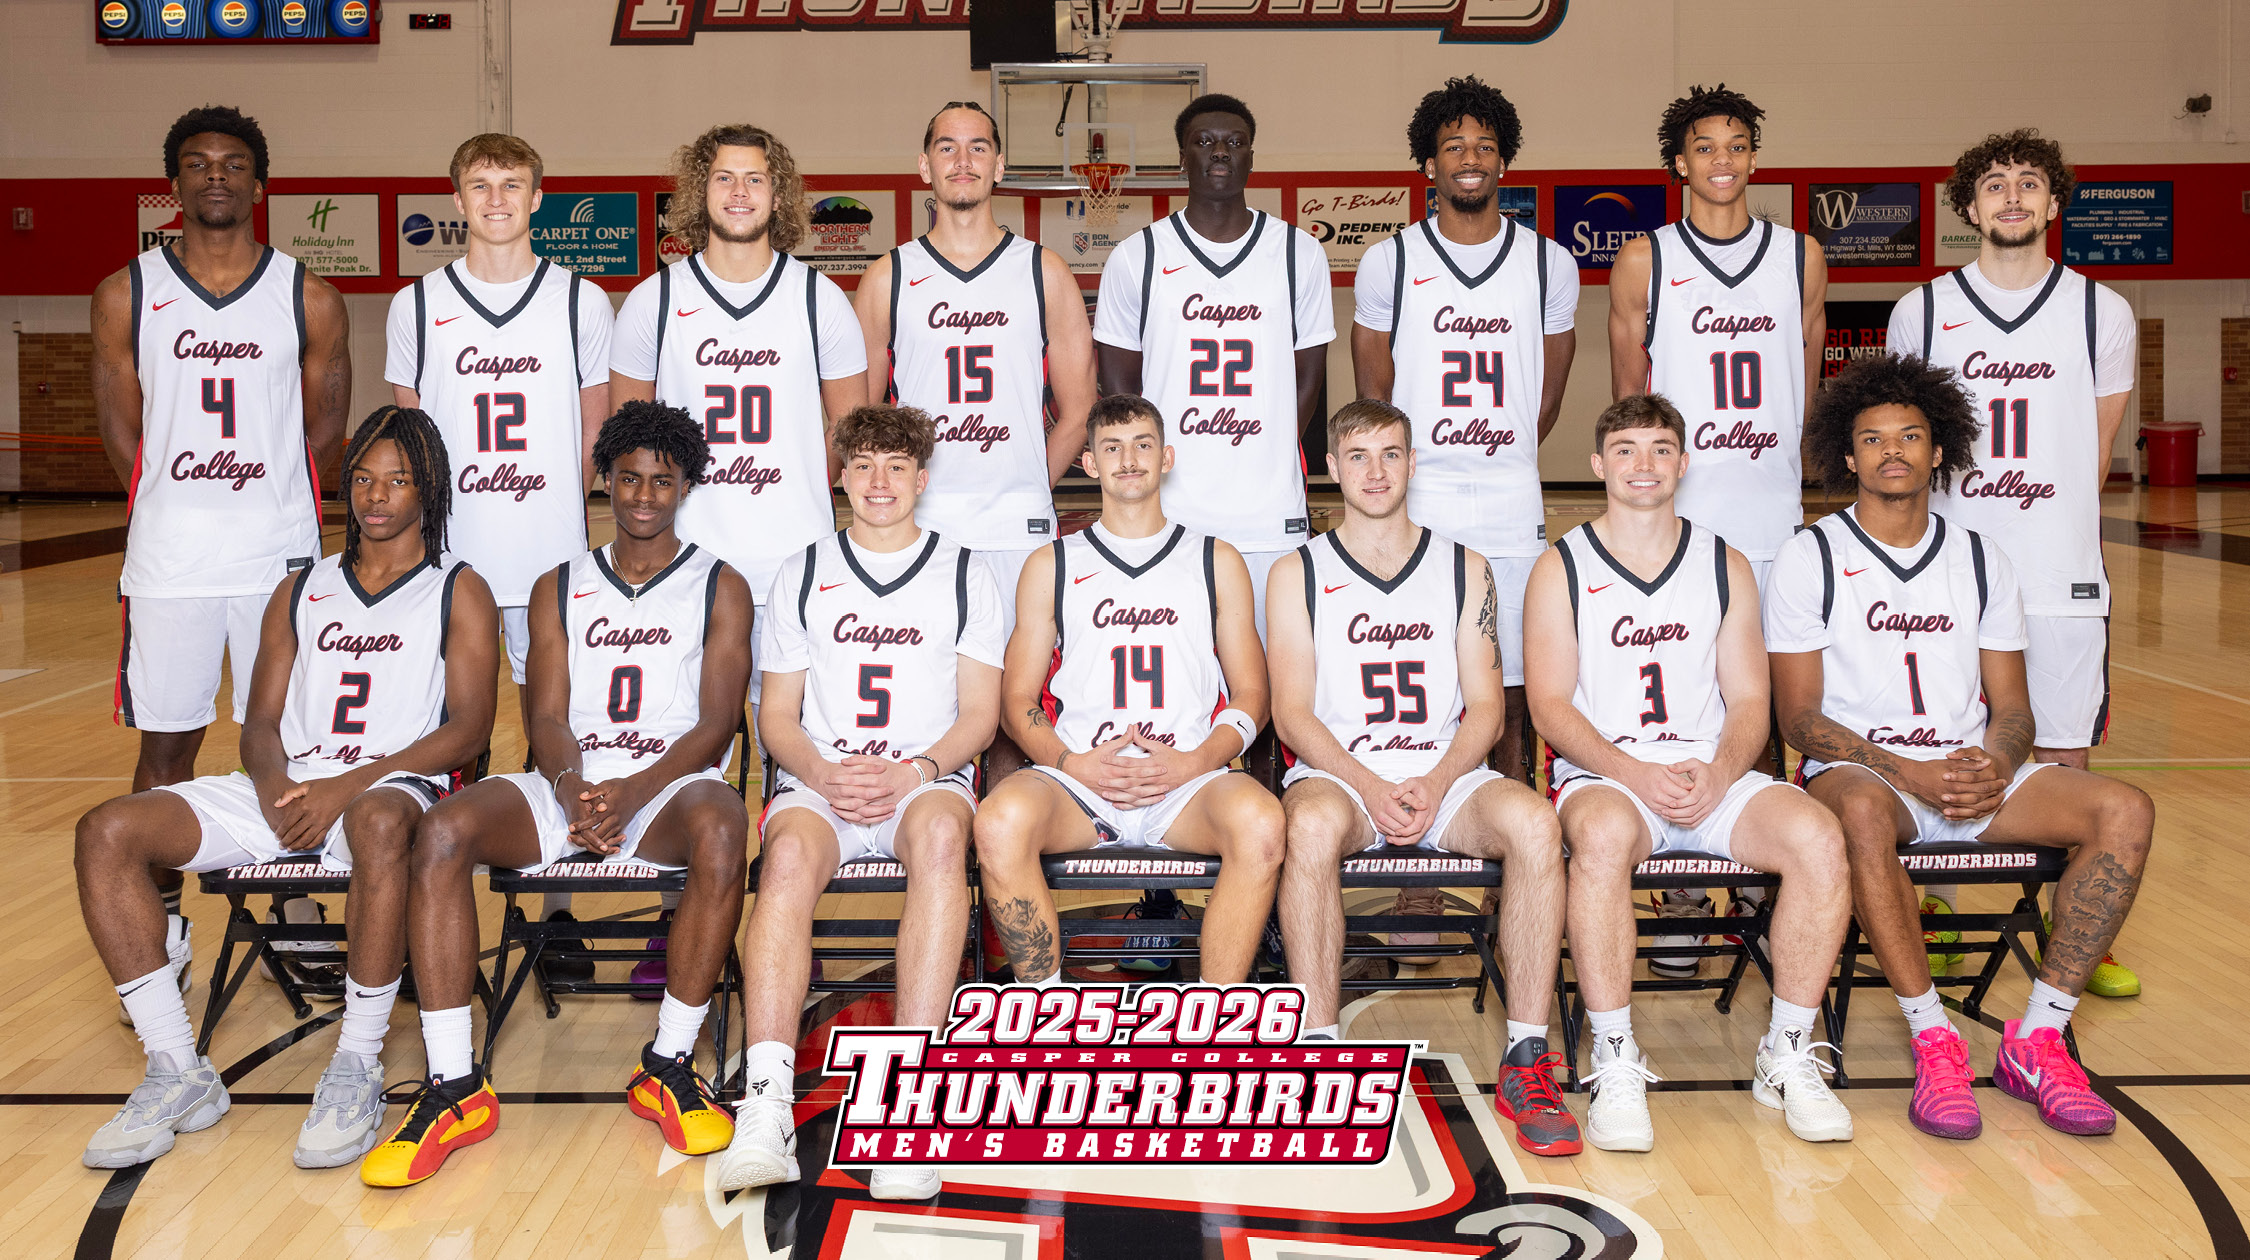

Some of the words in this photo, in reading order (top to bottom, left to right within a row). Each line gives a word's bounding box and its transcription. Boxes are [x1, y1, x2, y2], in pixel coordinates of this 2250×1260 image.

[104, 10, 126, 18] PEPSI
[163, 10, 185, 18] PEPSI
[224, 10, 246, 18] PEPSI
[284, 10, 305, 18] PEPSI
[346, 10, 367, 18] PEPSI
[1301, 199, 1325, 216] Go
[1333, 190, 1406, 212] T-Birds!
[2091, 188, 2155, 200] FERGUSON
[811, 223, 870, 234] NORTHERN
[1339, 222, 1406, 233] PEDEN'S
[1857, 207, 1909, 217] WESTERN
[292, 236, 335, 248] Holiday
[336, 236, 354, 247] Inn
[530, 227, 589, 240] CARPET
[821, 233, 859, 245] LIGHTS
[1337, 234, 1366, 245] INC.
[1830, 245, 1856, 253] Highway
[1839, 236, 1890, 244] 307.234.5029
[1941, 235, 1977, 243] BARKER
[316, 256, 358, 265] 577-5000
[334, 265, 357, 273] Peak
[359, 264, 372, 273] Dr.
[565, 256, 575, 264] E.
[576, 255, 594, 264] 2nd
[597, 255, 627, 264] Street
[813, 263, 868, 272] 307.237.3994
[1592, 253, 1609, 262] INN
[928, 301, 1009, 335] Casper
[1182, 293, 1262, 328] Casper
[1433, 305, 1512, 340] Casper
[1691, 305, 1776, 340] Casper
[174, 329, 263, 366] Casper
[696, 338, 781, 373] Casper
[1825, 328, 1852, 348] GO
[1825, 346, 1845, 361] GO
[1848, 346, 1887, 361] WHI
[456, 346, 542, 381] Casper
[945, 345, 994, 404] 15
[1189, 338, 1254, 397] 22
[1442, 350, 1504, 408] 24
[1710, 350, 1762, 411] 10
[1962, 350, 2056, 387] Casper
[201, 378, 236, 439] 4
[474, 392, 527, 452] 12
[705, 384, 772, 444] 20
[933, 413, 1010, 453] College
[1179, 407, 1262, 446] College
[1431, 418, 1515, 456] College
[1694, 420, 1779, 461] College
[1988, 398, 2029, 459] 11
[171, 450, 265, 491] College
[458, 463, 546, 502] College
[698, 455, 782, 495] College
[1960, 469, 2056, 510] College
[833, 613, 923, 651] Casper
[1092, 598, 1178, 633] Casper
[1347, 613, 1434, 650] Casper
[1866, 600, 1953, 640] Casper
[317, 621, 404, 660] Casper
[585, 616, 672, 653] Casper
[1611, 615, 1689, 653] Casper
[607, 665, 643, 723] 0
[1110, 645, 1164, 709] 14
[1360, 660, 1428, 726] 55
[1639, 662, 1668, 727] 3
[1904, 652, 1927, 715] 1
[331, 671, 372, 735] 2
[856, 663, 893, 728] 5
[1065, 859, 1206, 875] THUNDERBIRDS
[1344, 858, 1484, 873] THUNDERBIRDS
[1898, 853, 2038, 869] THUNDERBIRDS
